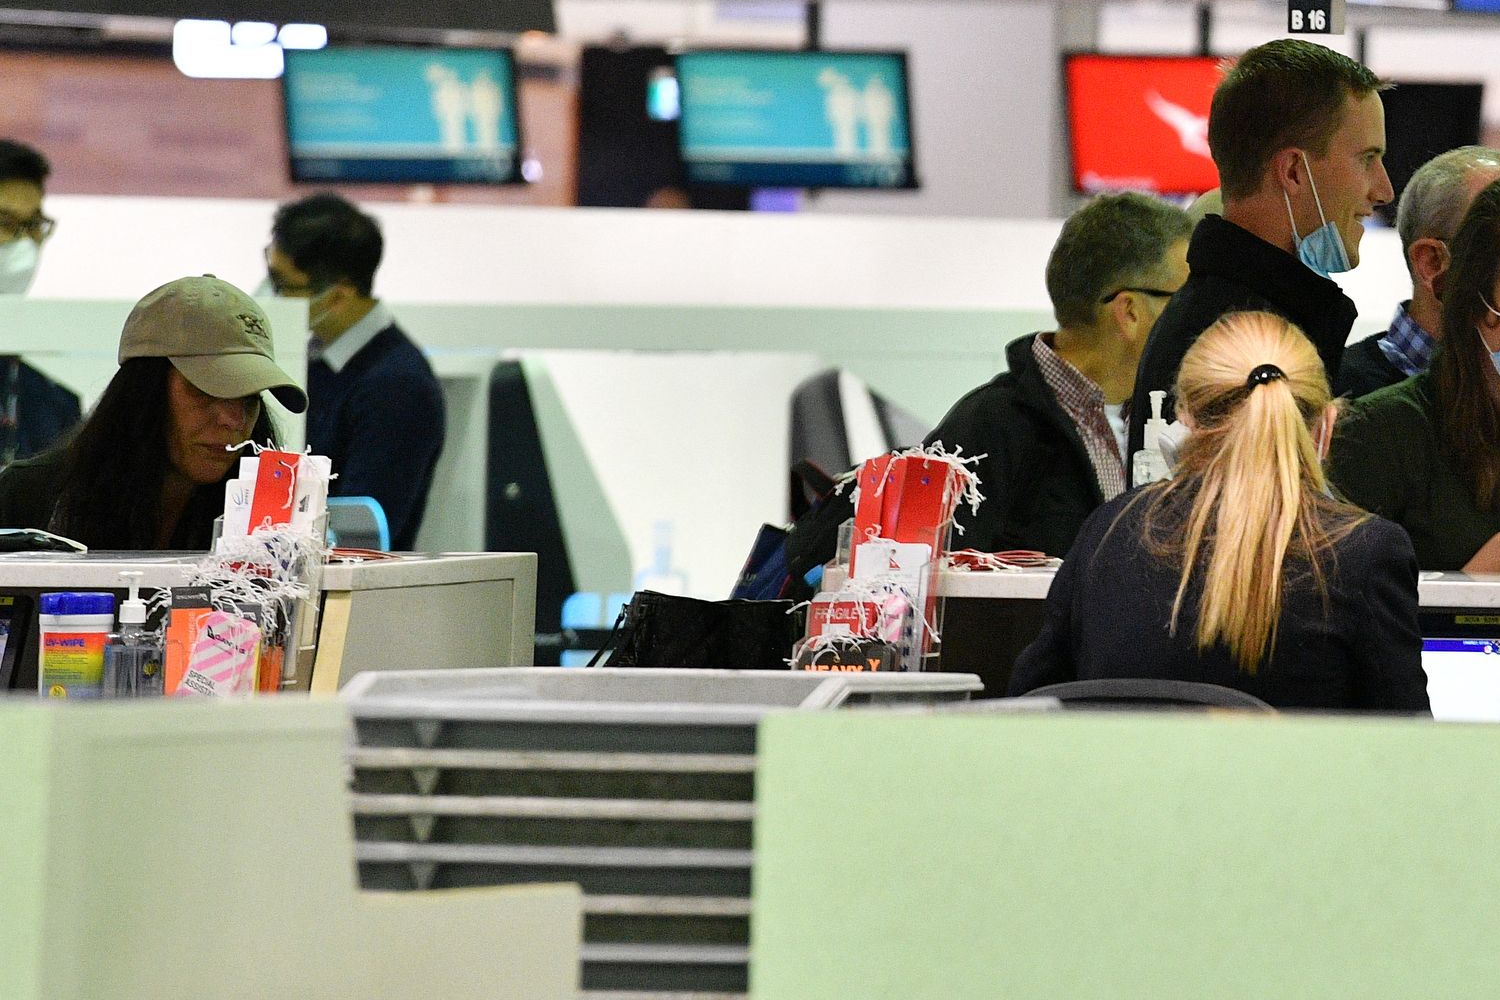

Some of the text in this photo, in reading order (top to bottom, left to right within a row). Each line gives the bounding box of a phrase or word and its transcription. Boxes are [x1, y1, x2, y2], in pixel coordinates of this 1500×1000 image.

[1291, 9, 1326, 30] B 16
[188, 669, 216, 690] SPECIAL
